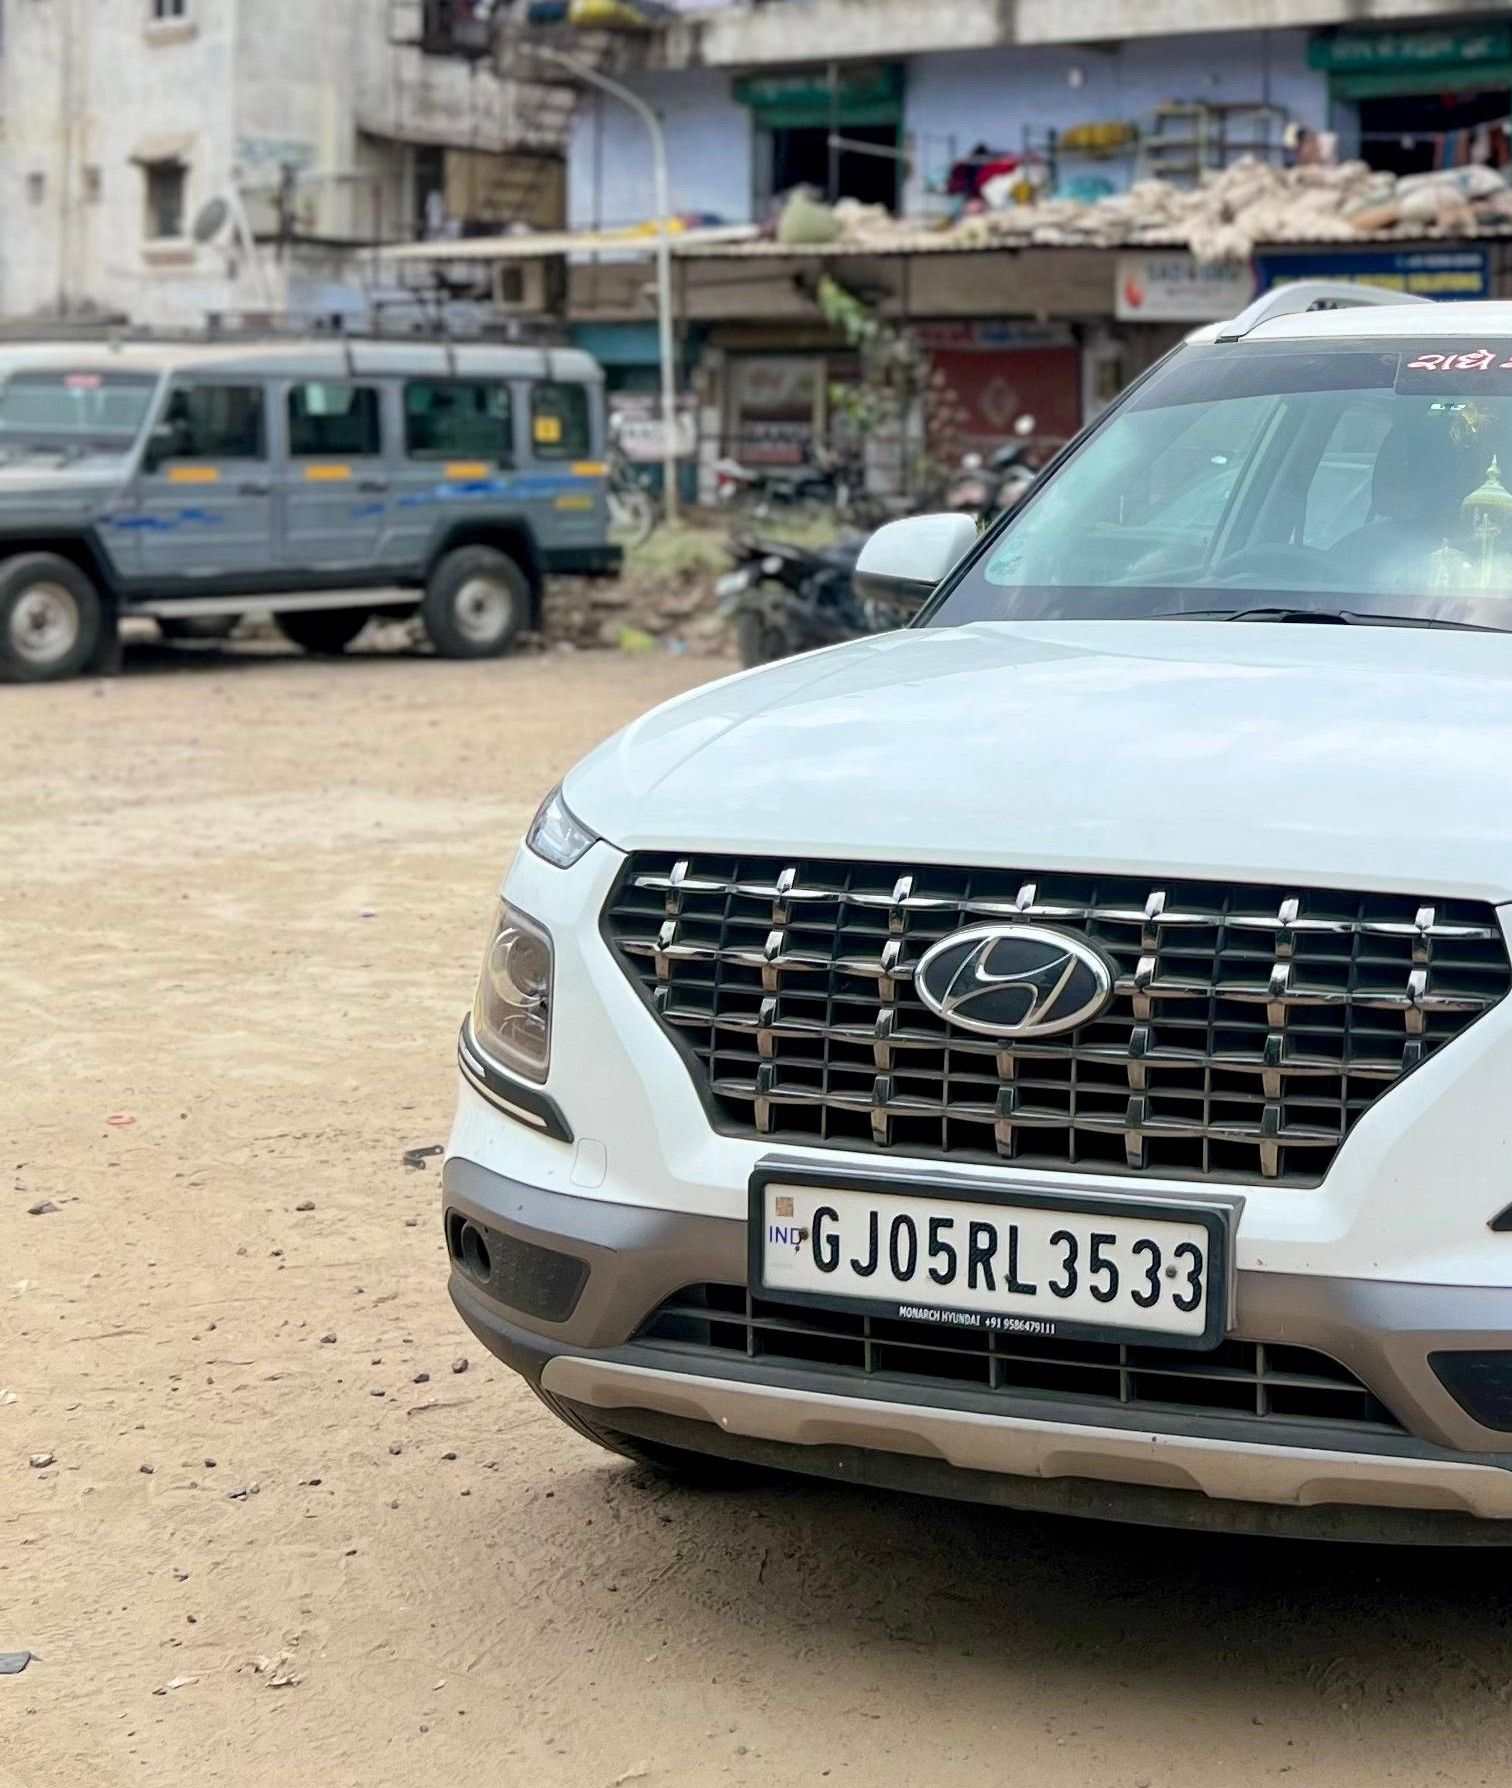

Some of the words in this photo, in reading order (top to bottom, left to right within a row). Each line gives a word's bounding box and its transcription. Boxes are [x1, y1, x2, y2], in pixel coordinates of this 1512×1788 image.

[1406, 349, 1496, 372] રાધે
[811, 1205, 1204, 1313] GJ05RL3533
[899, 1305, 940, 1322] MONARCH
[941, 1310, 981, 1327] HYUNDAI
[985, 1316, 1001, 1330] +91
[1003, 1318, 1056, 1335] 9586479111
